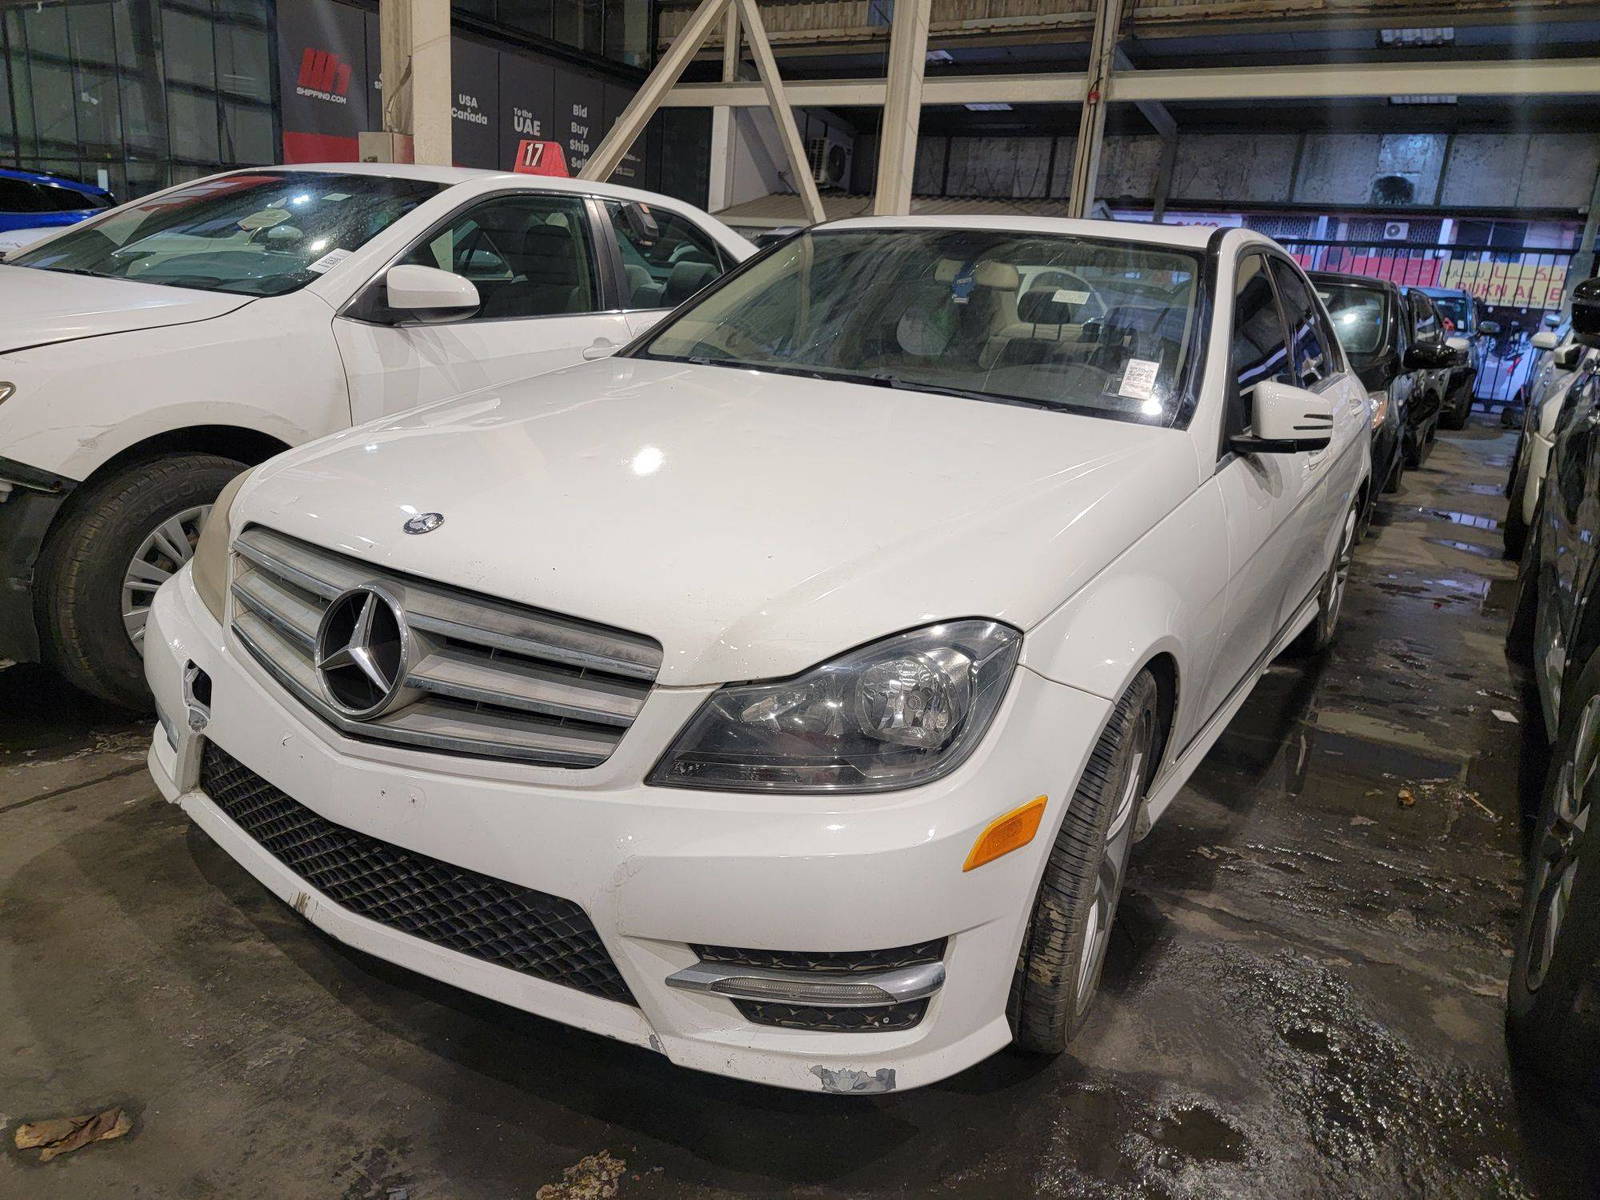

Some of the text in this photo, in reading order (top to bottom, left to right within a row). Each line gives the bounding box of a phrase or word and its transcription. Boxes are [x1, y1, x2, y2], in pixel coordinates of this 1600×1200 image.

[296, 87, 347, 104] SHIPPING.COM
[458, 94, 478, 108] USA
[451, 107, 488, 125] Canada
[513, 107, 533, 119] To the
[573, 104, 588, 118] Bid
[513, 116, 541, 136] UAE
[571, 121, 589, 139] Buy
[525, 143, 544, 166] 17
[569, 139, 590, 156] Ship
[571, 157, 588, 169] Sel
